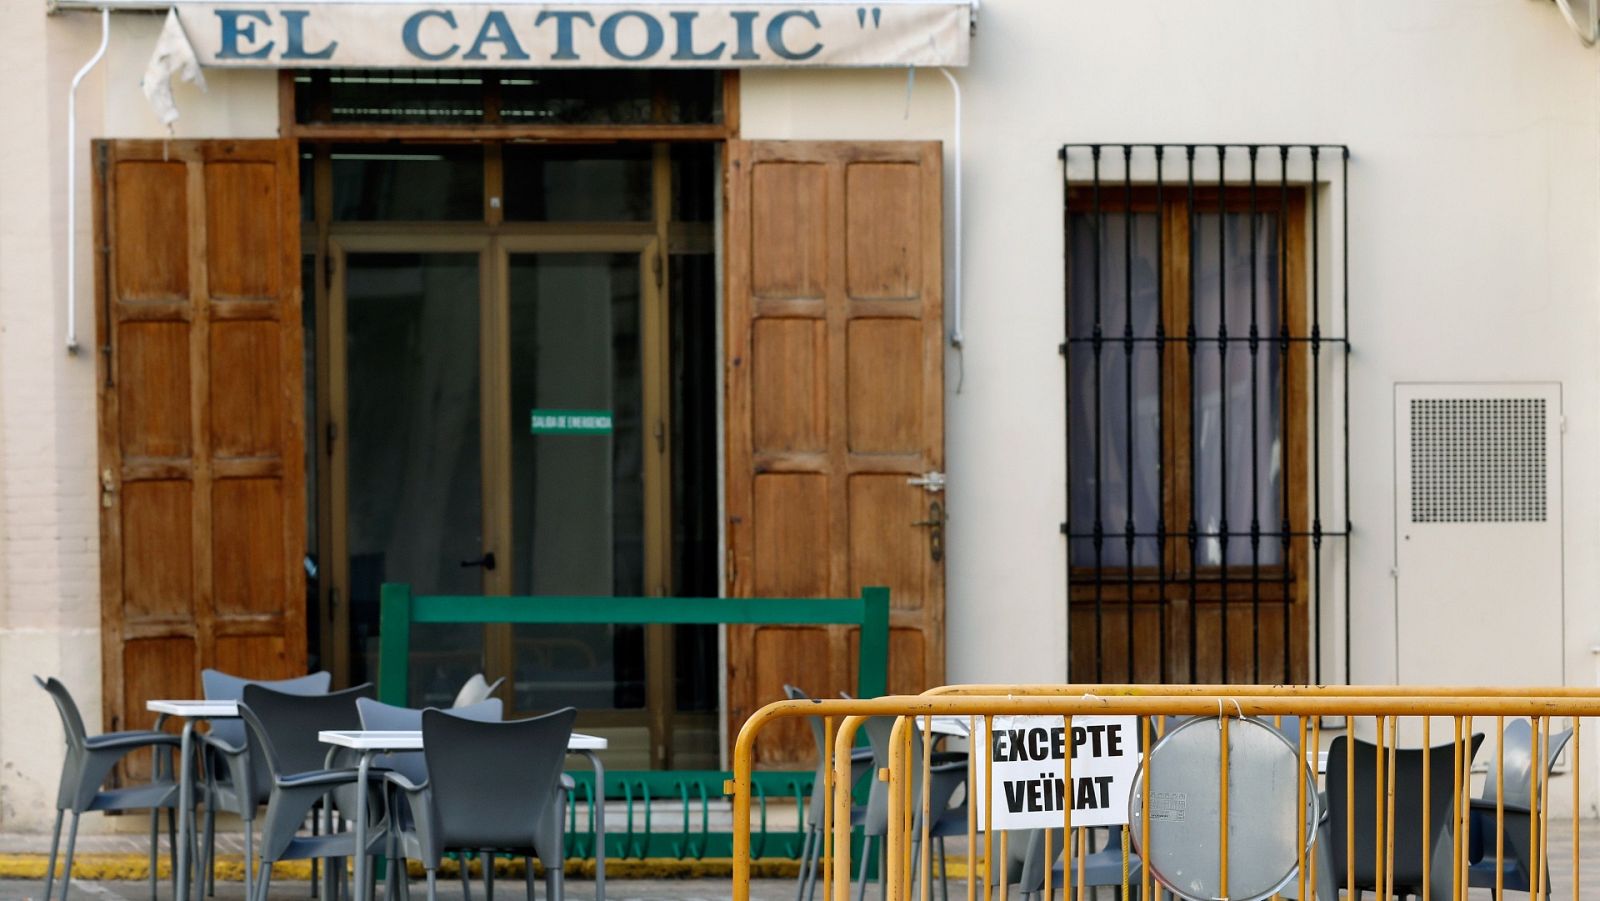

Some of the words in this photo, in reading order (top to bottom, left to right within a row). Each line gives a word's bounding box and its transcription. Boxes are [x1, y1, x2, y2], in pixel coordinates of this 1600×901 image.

[214, 9, 338, 60] EL
[401, 9, 824, 61] CATOLIC
[532, 416, 557, 428] SALIDA
[558, 416, 567, 428] DE
[992, 724, 1123, 762] EXCEPTE
[1003, 772, 1113, 813] VEÏNAT
